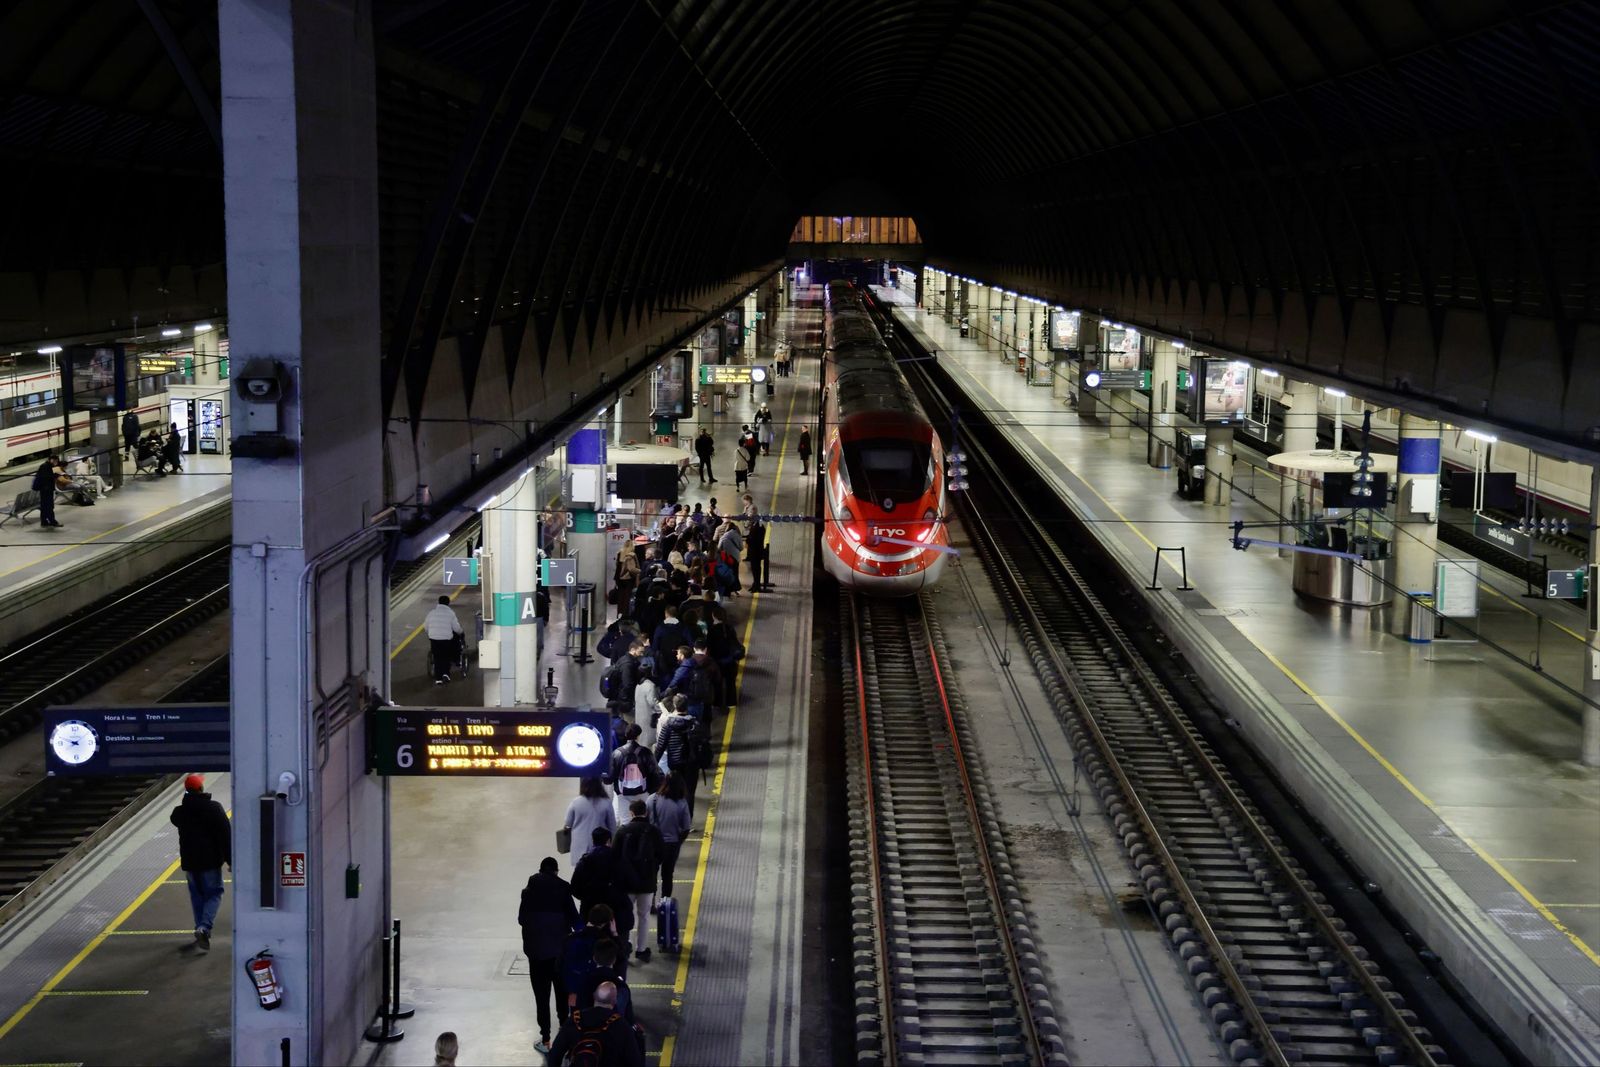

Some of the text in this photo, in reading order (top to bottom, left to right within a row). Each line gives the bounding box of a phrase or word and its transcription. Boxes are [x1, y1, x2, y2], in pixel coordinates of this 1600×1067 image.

[1139, 380, 1145, 388] 5
[597, 513, 607, 529] B
[612, 533, 625, 541] iryo
[873, 526, 906, 537] iryo
[445, 571, 453, 583] 7
[565, 572, 574, 584] 6
[1549, 584, 1558, 597] 5
[521, 597, 536, 619] A
[467, 725, 494, 736] IRYO
[397, 744, 413, 768] 6
[427, 745, 546, 756] MADRID PTA. ATOCHA
